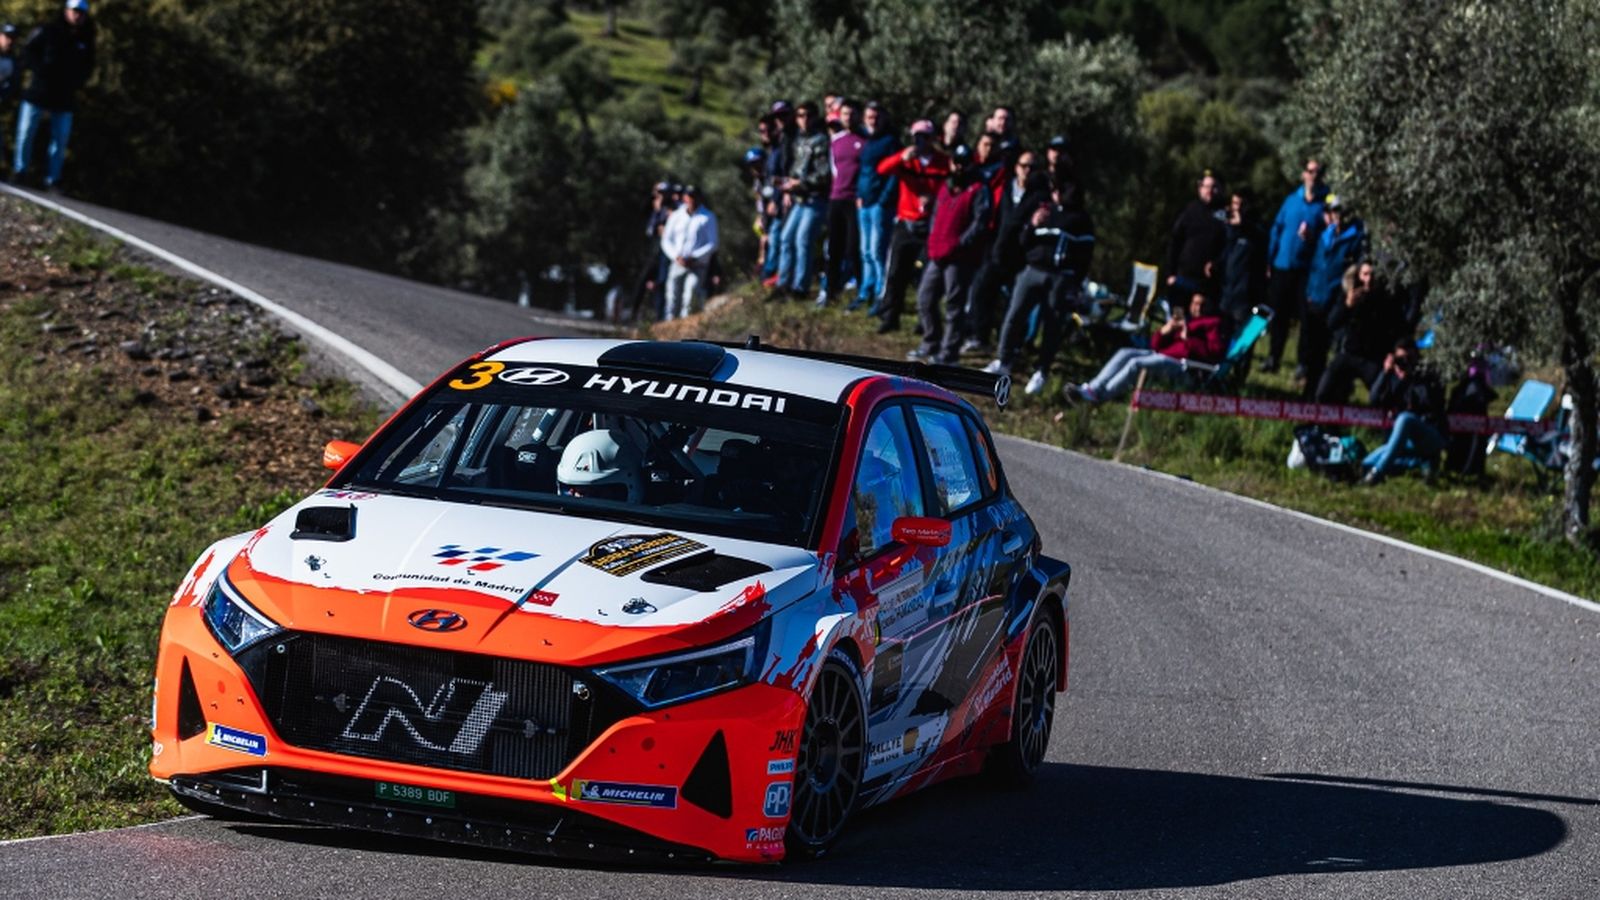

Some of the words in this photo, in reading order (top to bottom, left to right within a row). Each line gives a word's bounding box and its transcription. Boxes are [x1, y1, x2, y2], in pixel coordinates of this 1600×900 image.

[449, 361, 506, 391] 3
[583, 373, 787, 414] HYUNDAI
[453, 577, 470, 586] de
[474, 580, 525, 595] Madrid
[379, 784, 388, 793] P
[393, 787, 422, 799] 5389
[428, 790, 450, 802] BDF
[603, 788, 665, 802] MICHELIN
